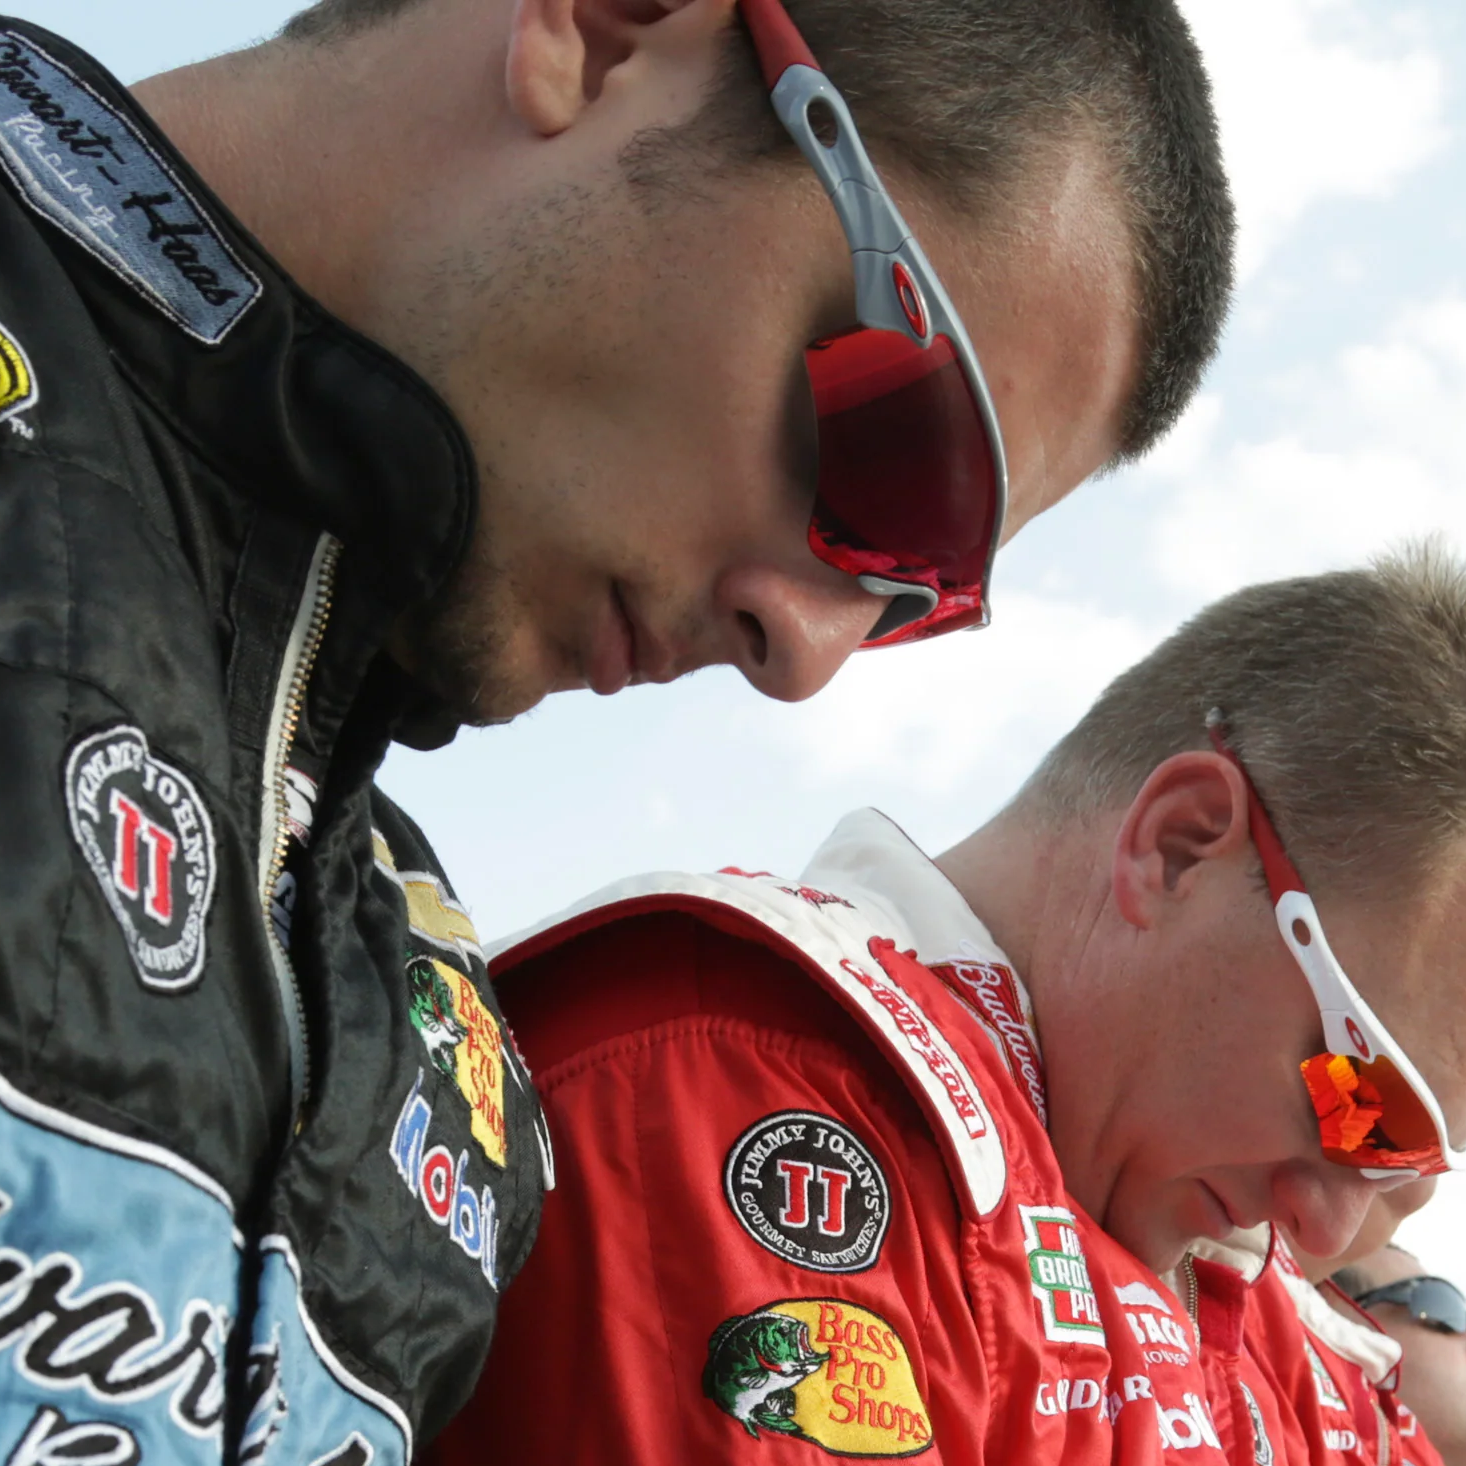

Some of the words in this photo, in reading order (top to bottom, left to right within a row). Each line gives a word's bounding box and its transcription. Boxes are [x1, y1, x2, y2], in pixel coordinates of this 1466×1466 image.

[741, 1124, 807, 1190] JIMMY
[813, 1127, 883, 1213] JOHN'S
[776, 1158, 853, 1237] JJ
[740, 1191, 807, 1259] GOURMET
[810, 1216, 878, 1265] SANDWICHES
[816, 1303, 897, 1361] Bass
[826, 1344, 886, 1391] Pro
[828, 1384, 932, 1444] Shops
